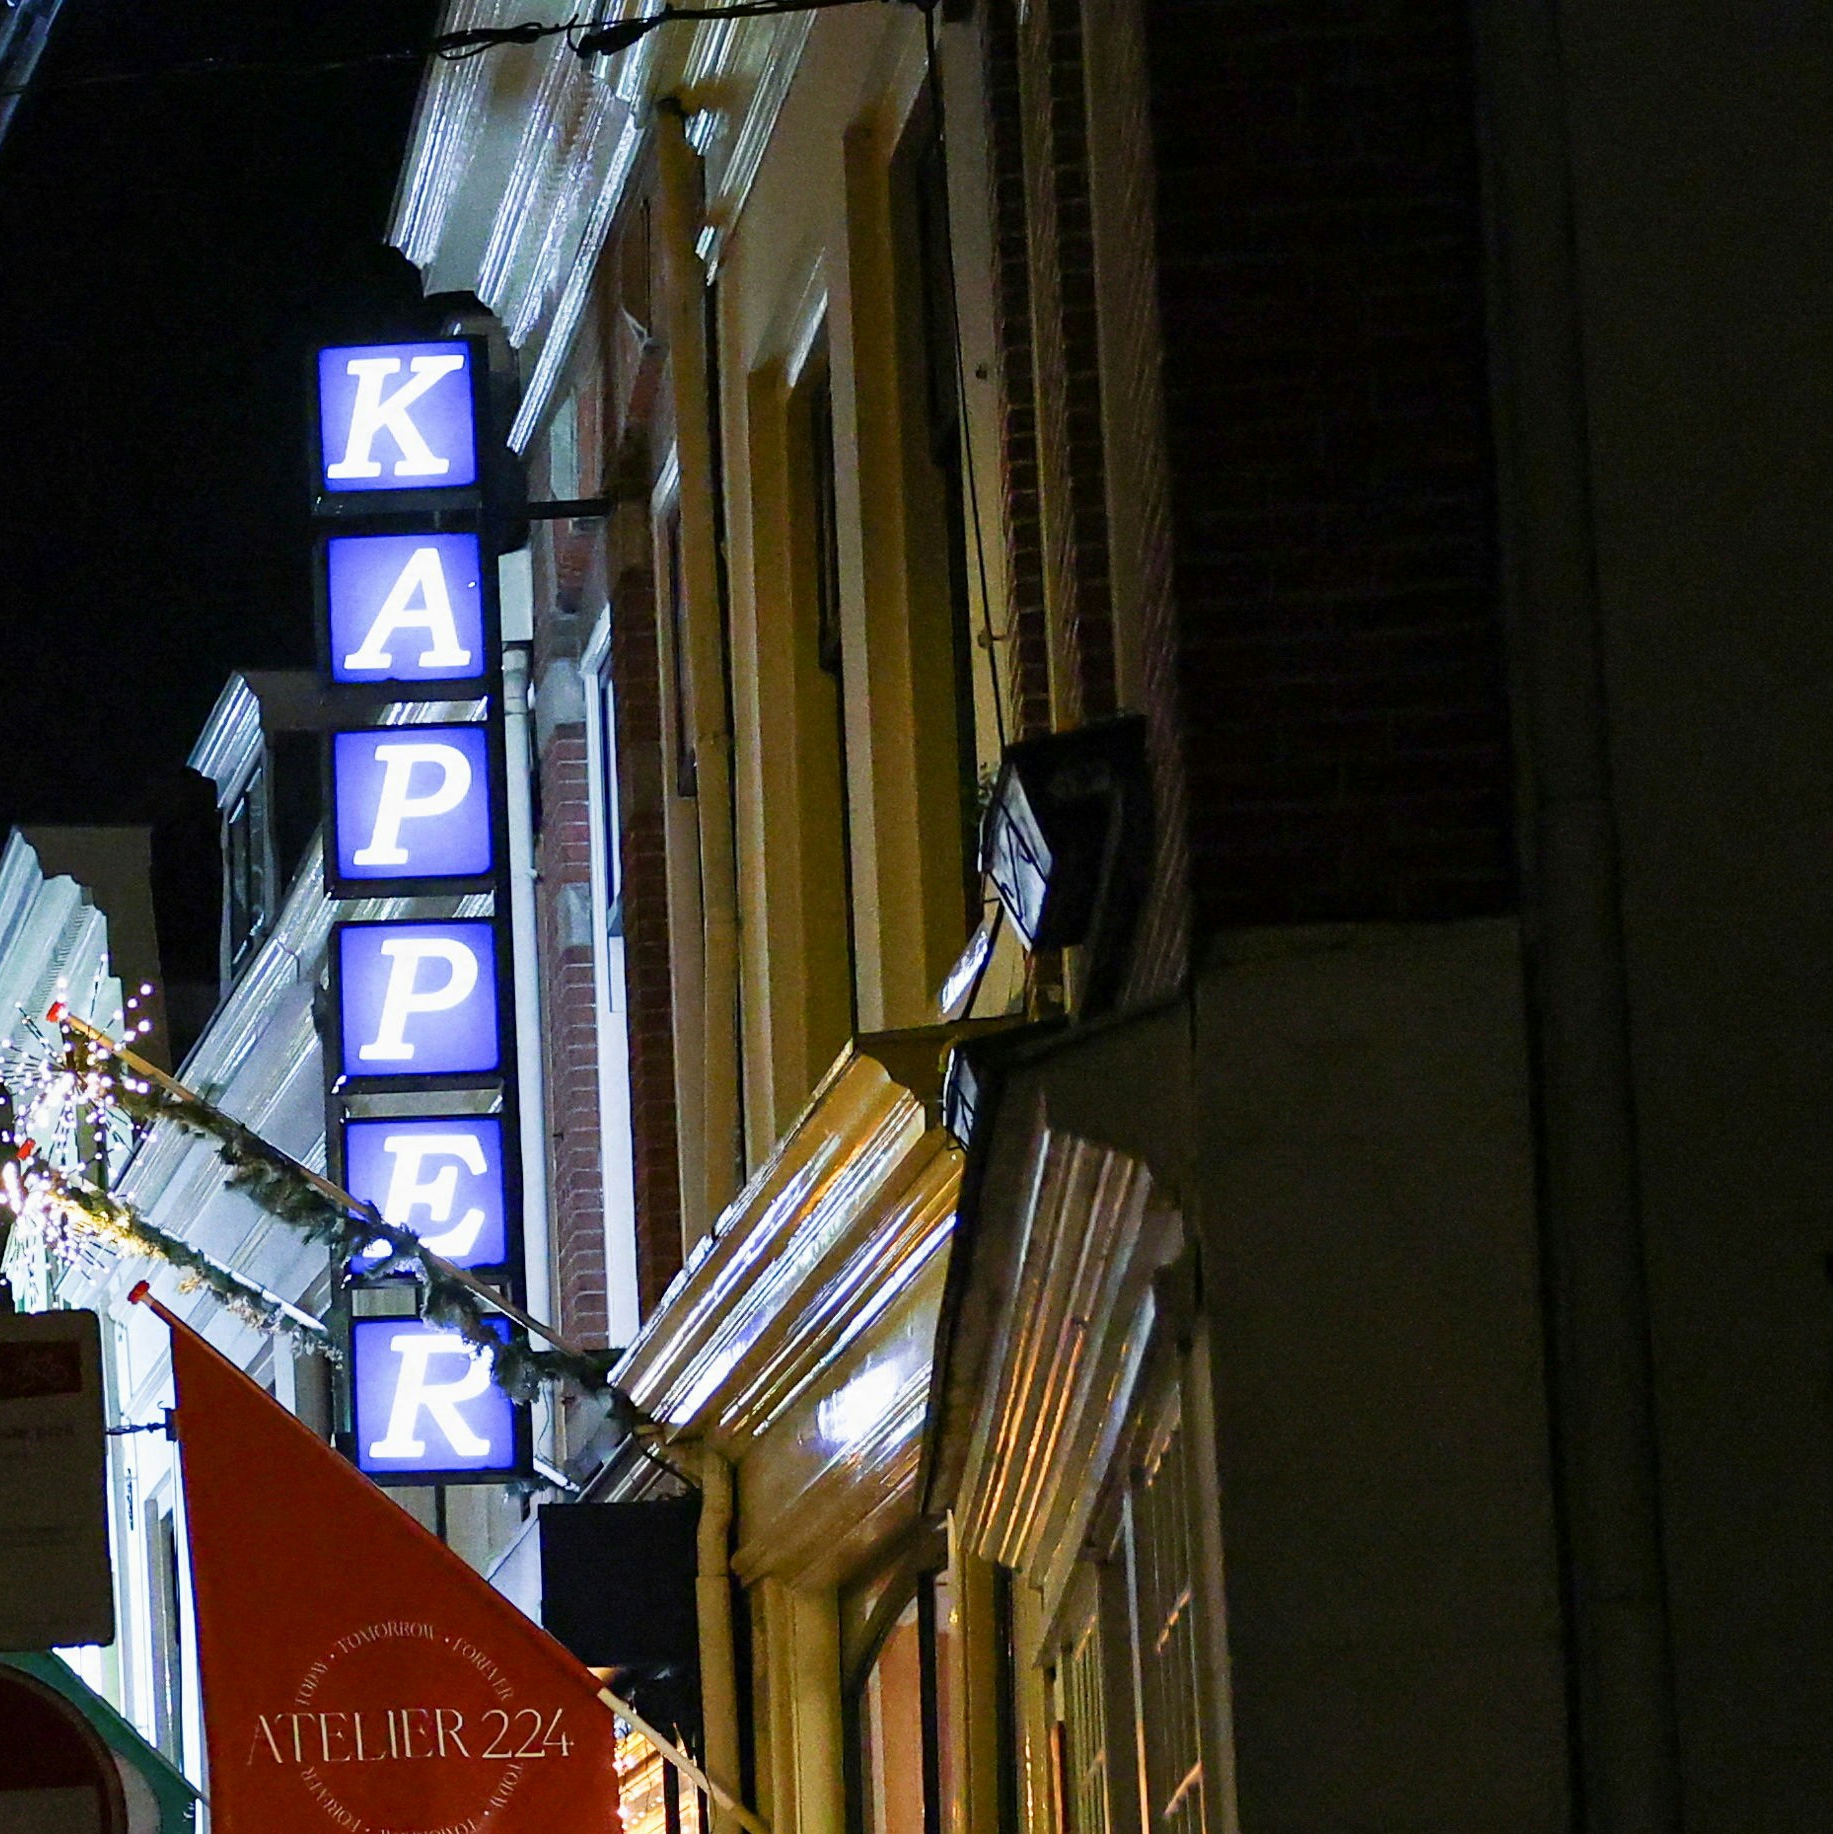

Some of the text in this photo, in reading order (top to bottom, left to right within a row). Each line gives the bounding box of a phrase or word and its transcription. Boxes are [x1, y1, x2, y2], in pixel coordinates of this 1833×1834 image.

[327, 355, 494, 1458] KAPPER
[295, 1619, 515, 1706] TODAY TOMORROW FOREVER
[246, 1707, 575, 1765] ATELIER 224
[301, 1766, 362, 1833] FOREVER
